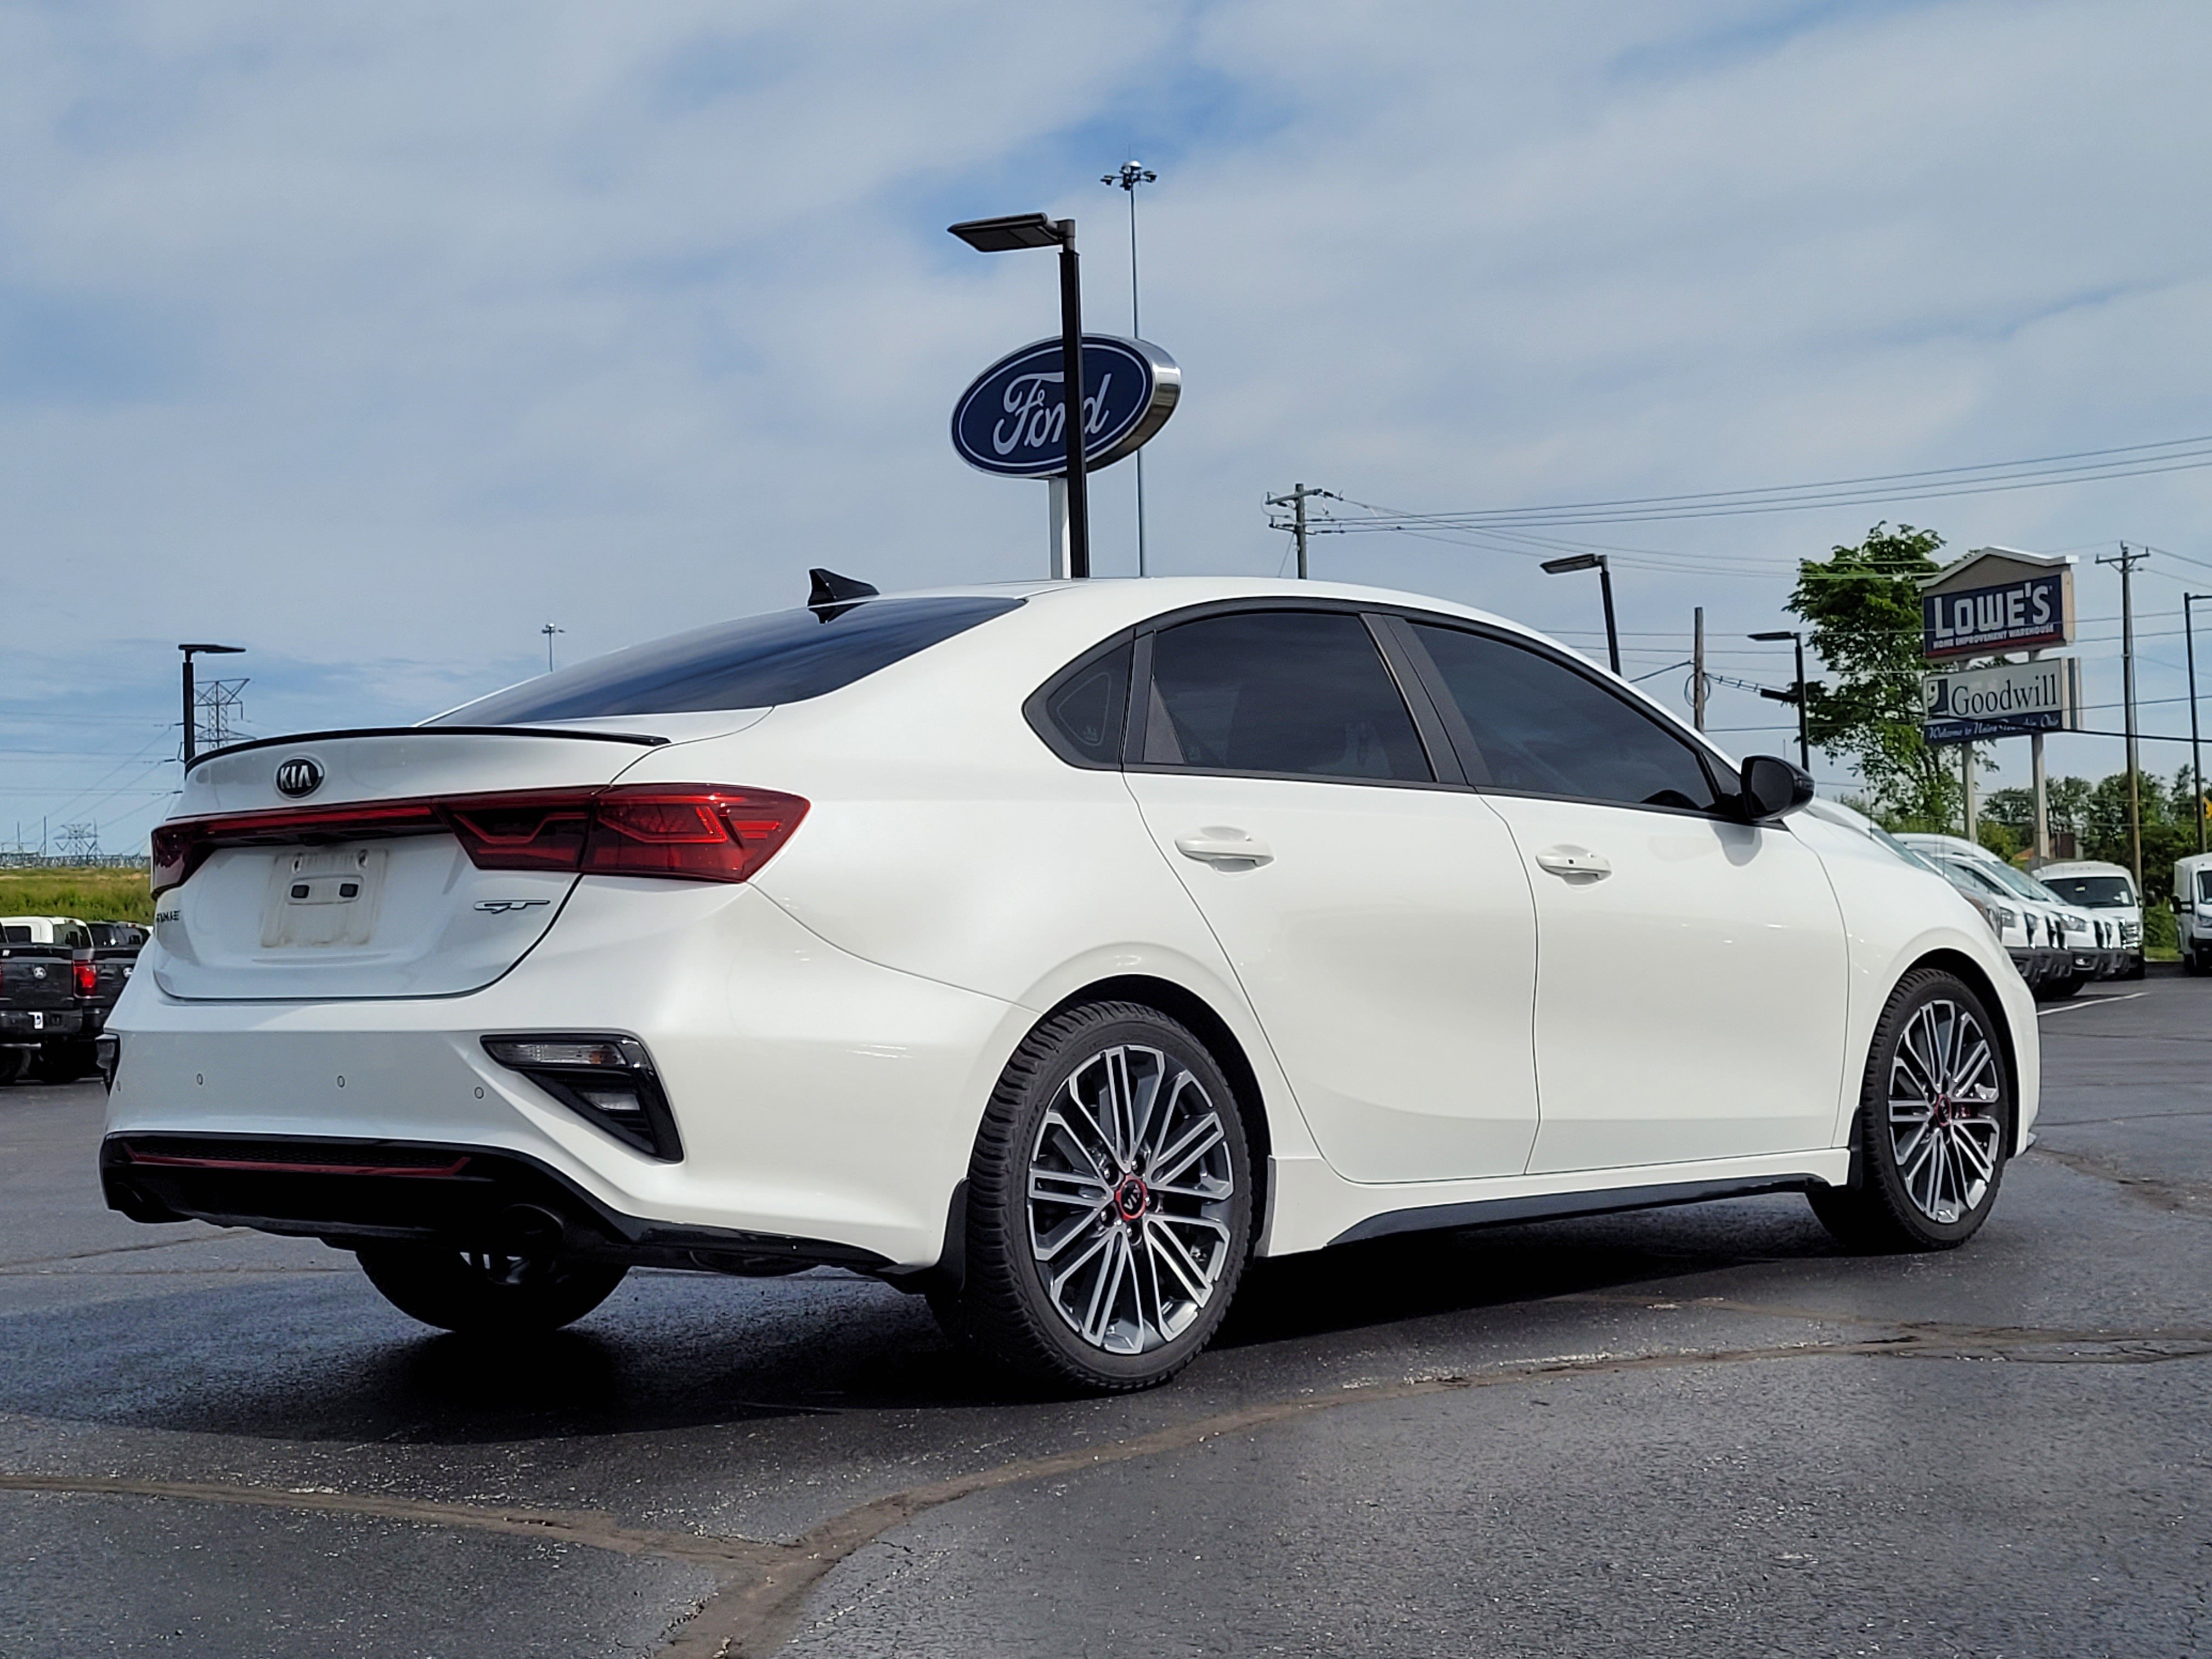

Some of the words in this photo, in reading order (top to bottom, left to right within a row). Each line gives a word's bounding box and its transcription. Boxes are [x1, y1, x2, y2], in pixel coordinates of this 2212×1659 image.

[1933, 582, 2051, 639] LOWE'S
[1933, 638, 1954, 650] HOME
[1955, 630, 2007, 646] IMPROVEMENT
[2008, 623, 2054, 638] WAREHOUSE
[1951, 673, 2057, 716] Goodwill
[280, 765, 312, 790] KIA
